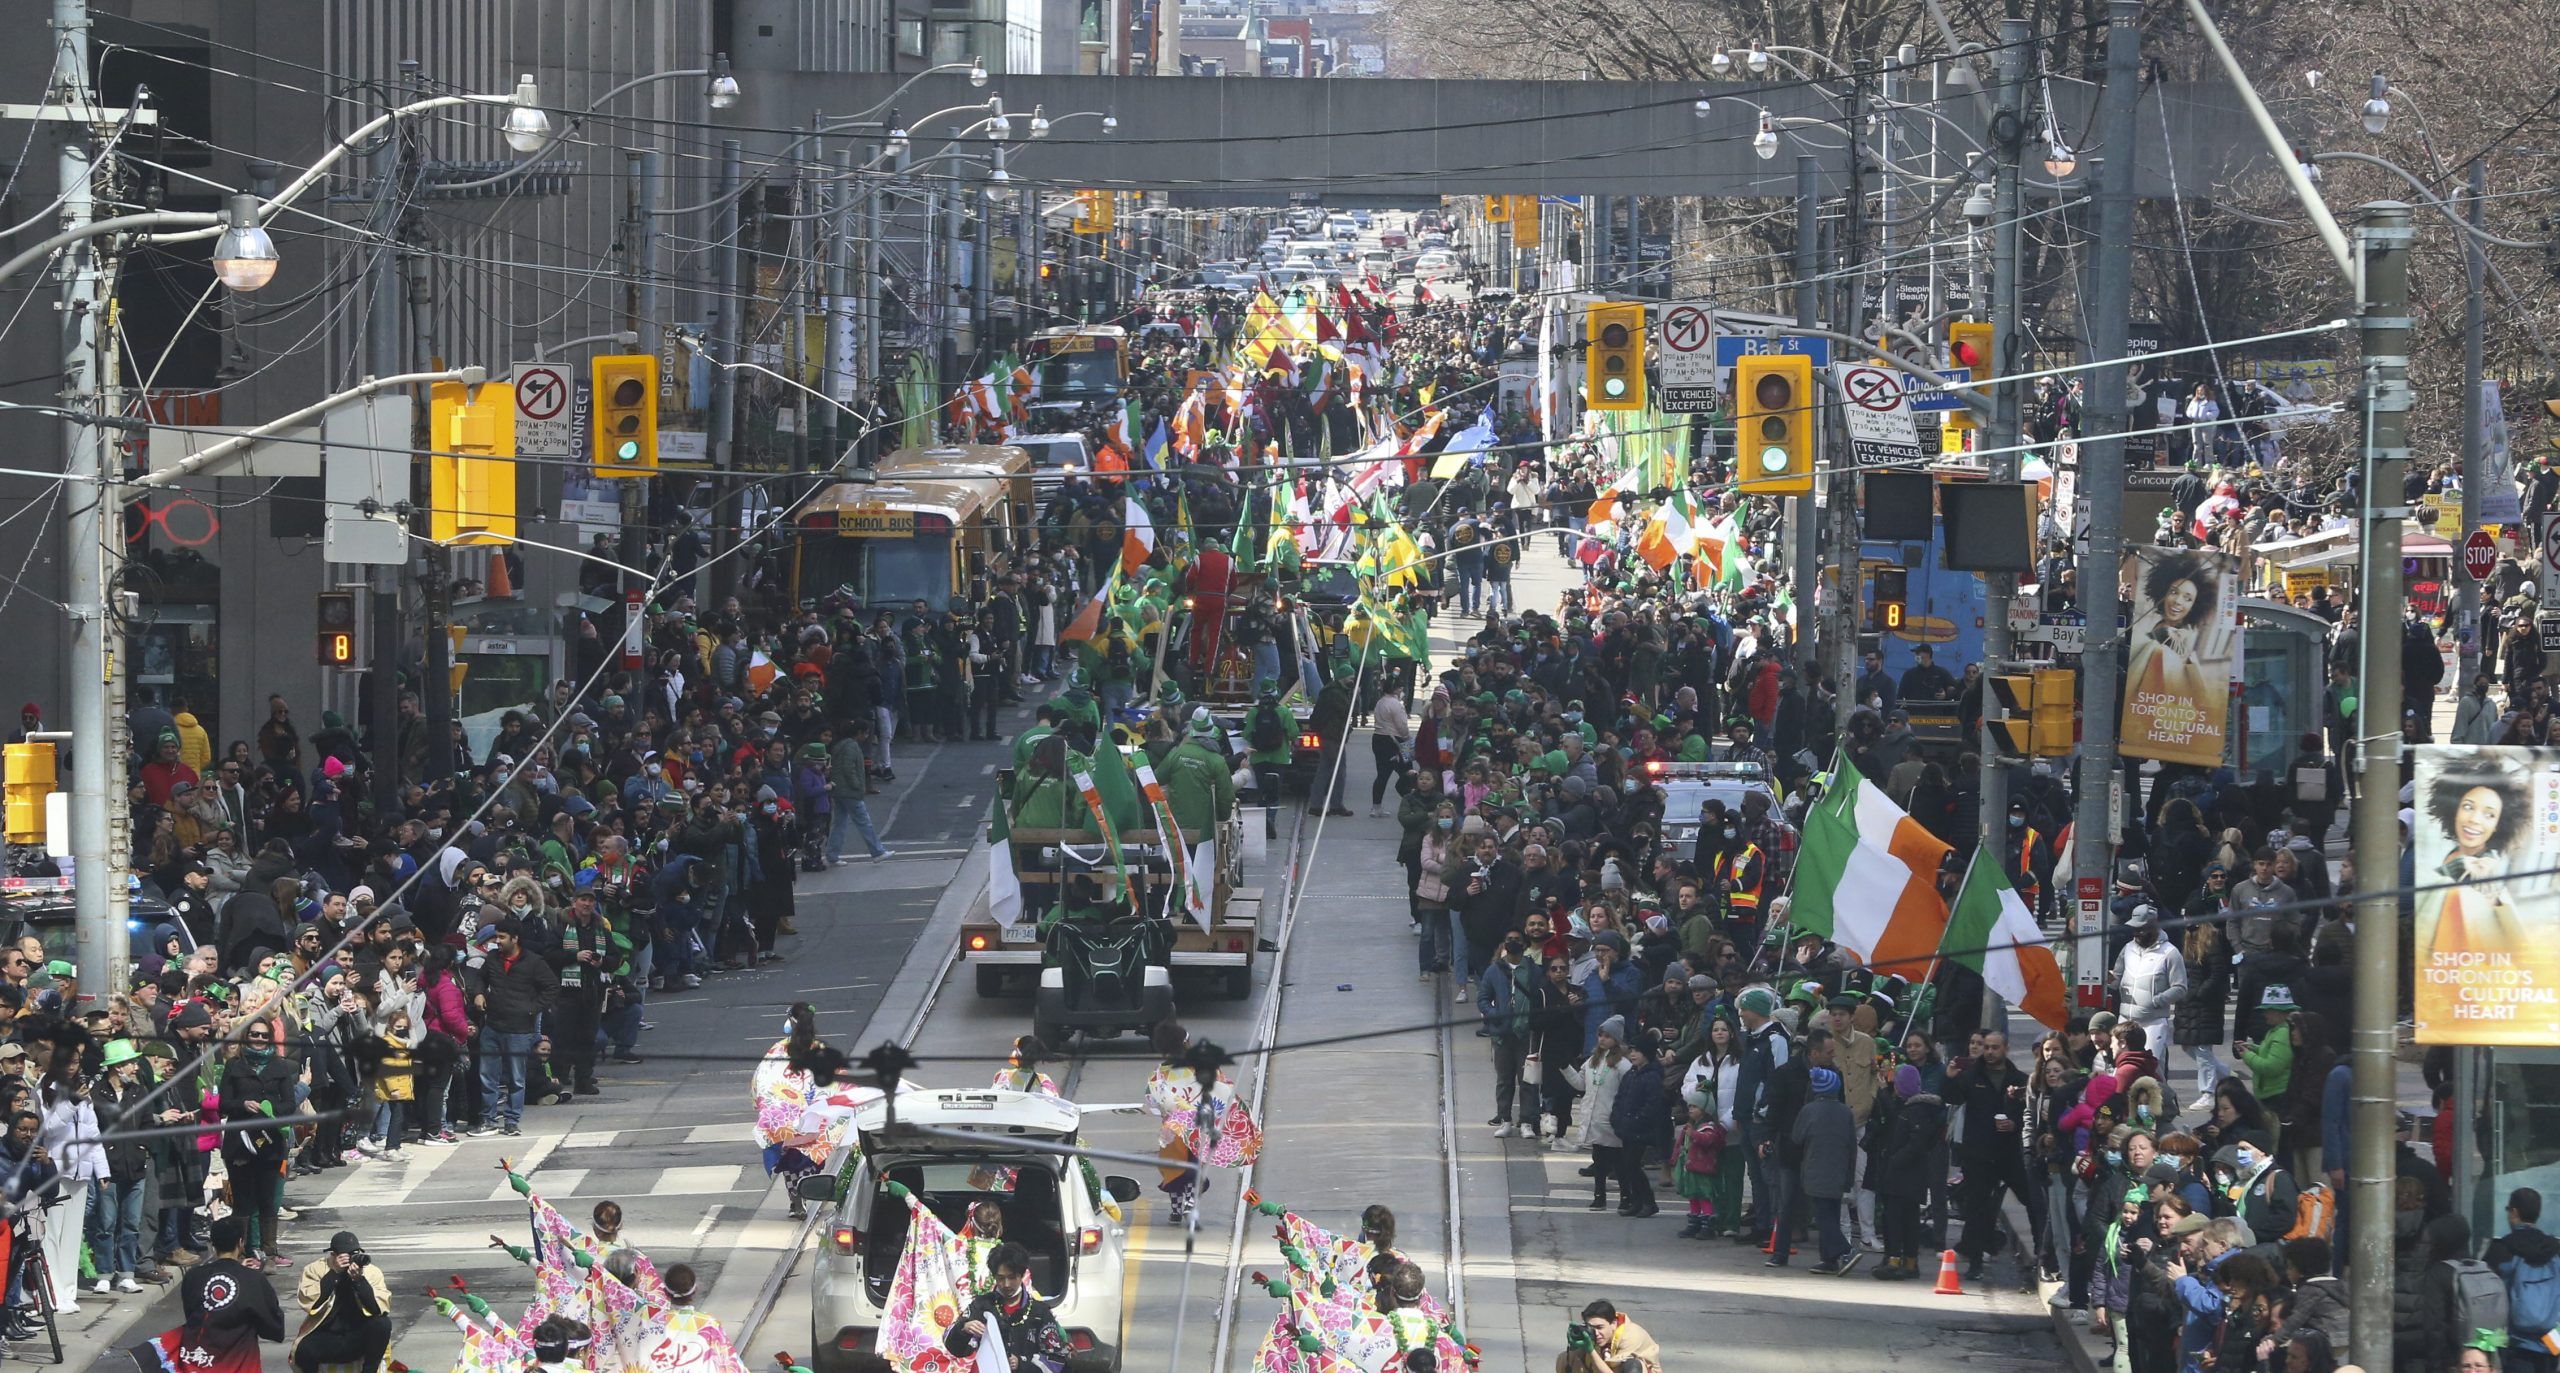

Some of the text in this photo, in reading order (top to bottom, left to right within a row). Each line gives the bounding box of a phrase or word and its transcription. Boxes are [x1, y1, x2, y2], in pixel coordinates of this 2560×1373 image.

[1641, 249, 1666, 257] Beauty
[1900, 285, 1930, 294] Sleepin
[1900, 293, 1928, 301] Beauty
[1788, 340, 1799, 351] St
[662, 329, 676, 397] DISCOVER
[1663, 389, 1715, 400] TTC VEHICLES
[1908, 376, 1944, 406] Queen
[1665, 401, 1714, 410] EXCEPTED
[571, 385, 590, 459] CONNECT
[1855, 442, 1920, 458] TTC VEHICLES
[2128, 475, 2177, 486] Cncours
[840, 517, 913, 532] SCHOOL BUS
[2466, 546, 2495, 565] STOP
[2018, 599, 2030, 608] NO
[1888, 604, 1899, 627] 8
[2008, 608, 2038, 620] STANDING
[2053, 627, 2074, 643] Bay
[335, 635, 348, 660] 8
[2137, 691, 2193, 707] SHOP IN
[2130, 703, 2207, 722] TORONTO'S
[2153, 718, 2221, 737] CULTURAL
[2147, 730, 2193, 745] HEART
[2432, 951, 2512, 967] SHOP IN
[2423, 969, 2533, 986] TORONTO'S
[2459, 986, 2558, 1004] CULTURAL
[2453, 1004, 2518, 1020] HEART
